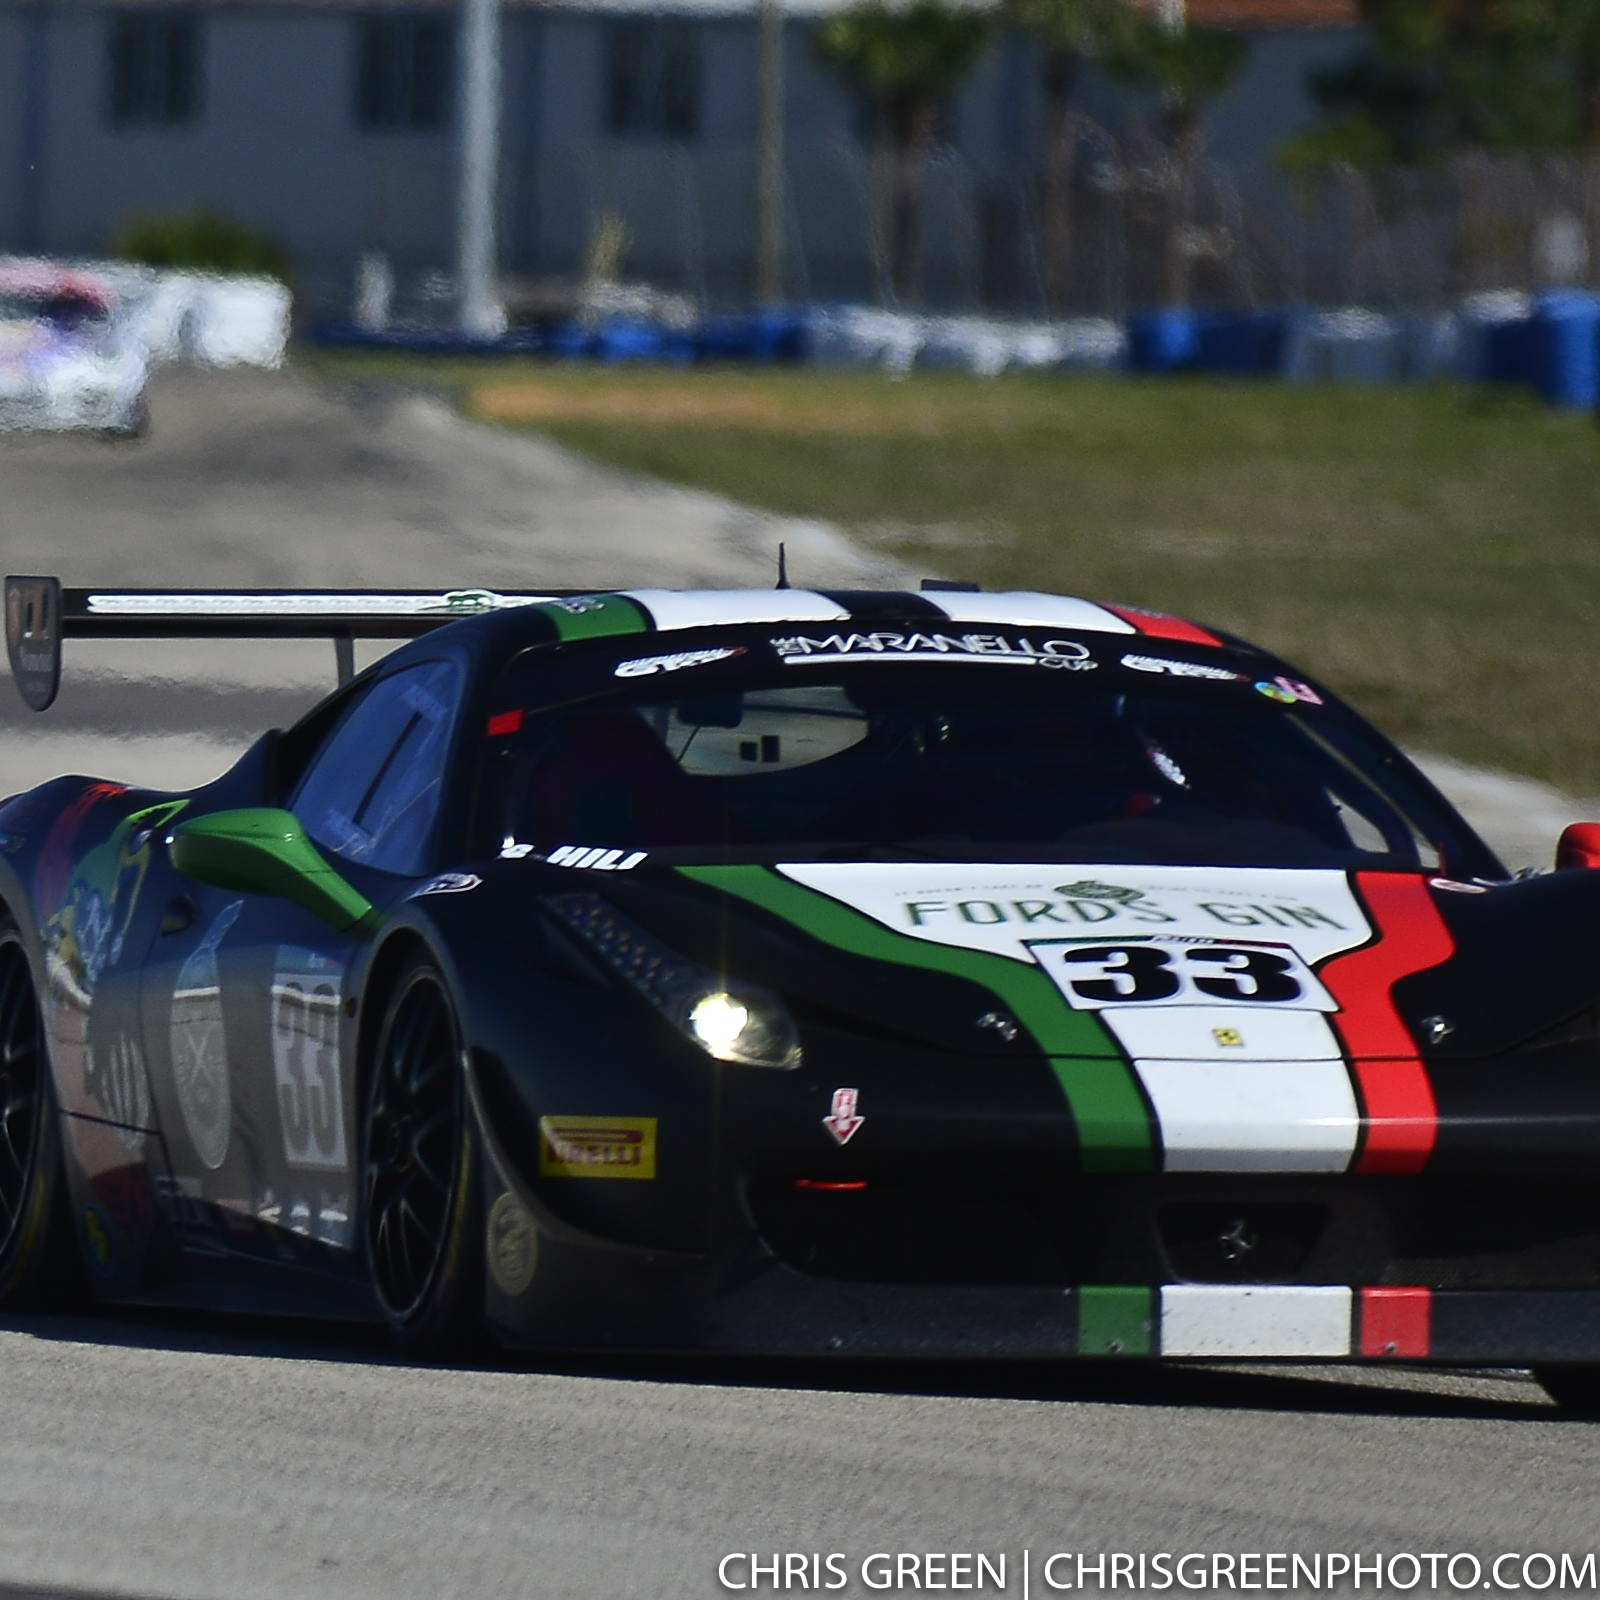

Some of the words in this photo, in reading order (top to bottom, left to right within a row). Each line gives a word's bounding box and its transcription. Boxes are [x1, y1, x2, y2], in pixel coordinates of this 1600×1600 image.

[796, 632, 1090, 660] MARANELLO
[1039, 656, 1099, 671] CUP
[905, 899, 1177, 926] FORDS
[1197, 902, 1349, 931] GIN
[1062, 944, 1302, 1003] 33
[276, 981, 341, 1157] 33
